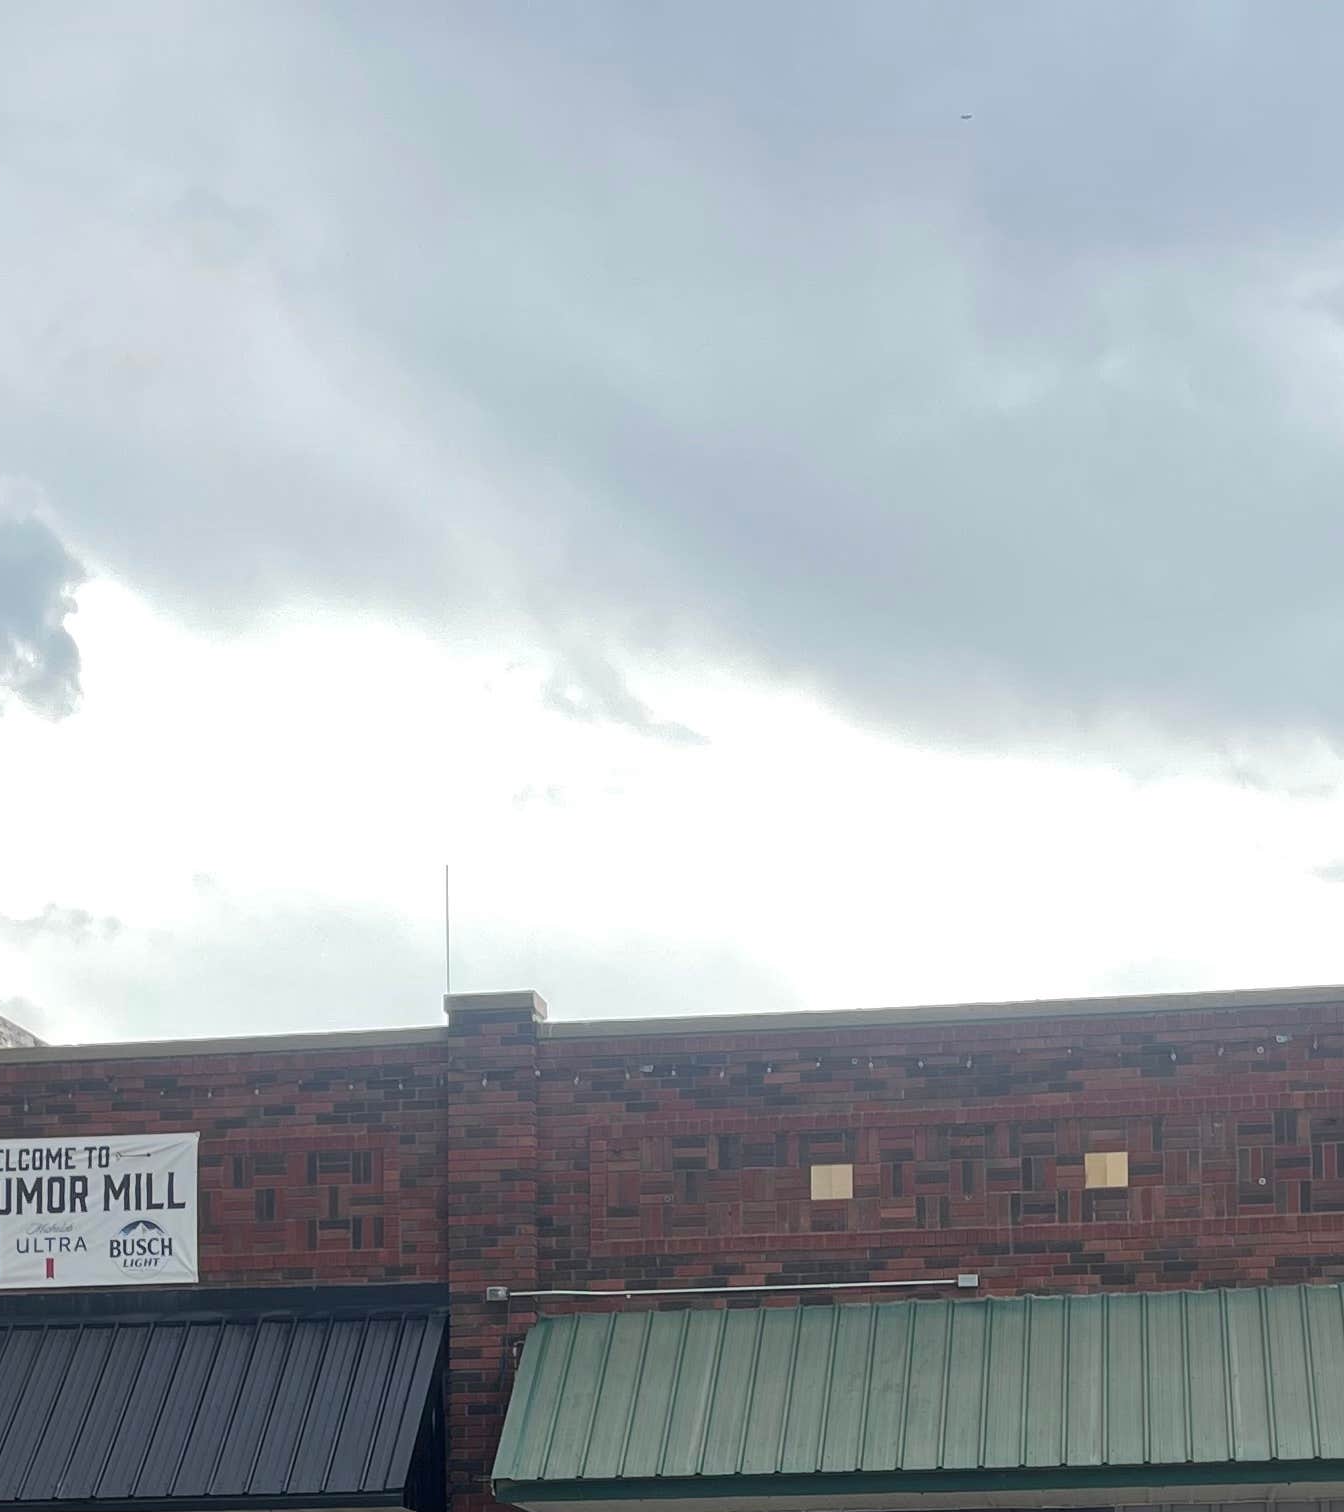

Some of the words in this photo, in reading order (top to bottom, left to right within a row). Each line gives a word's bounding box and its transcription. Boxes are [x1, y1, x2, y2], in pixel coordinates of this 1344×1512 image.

[84, 1145, 110, 1169] TO
[103, 1172, 186, 1212] MILL
[16, 1236, 88, 1253] ULTRA
[109, 1237, 173, 1258] BUSCH
[122, 1258, 160, 1268] LIGHT
